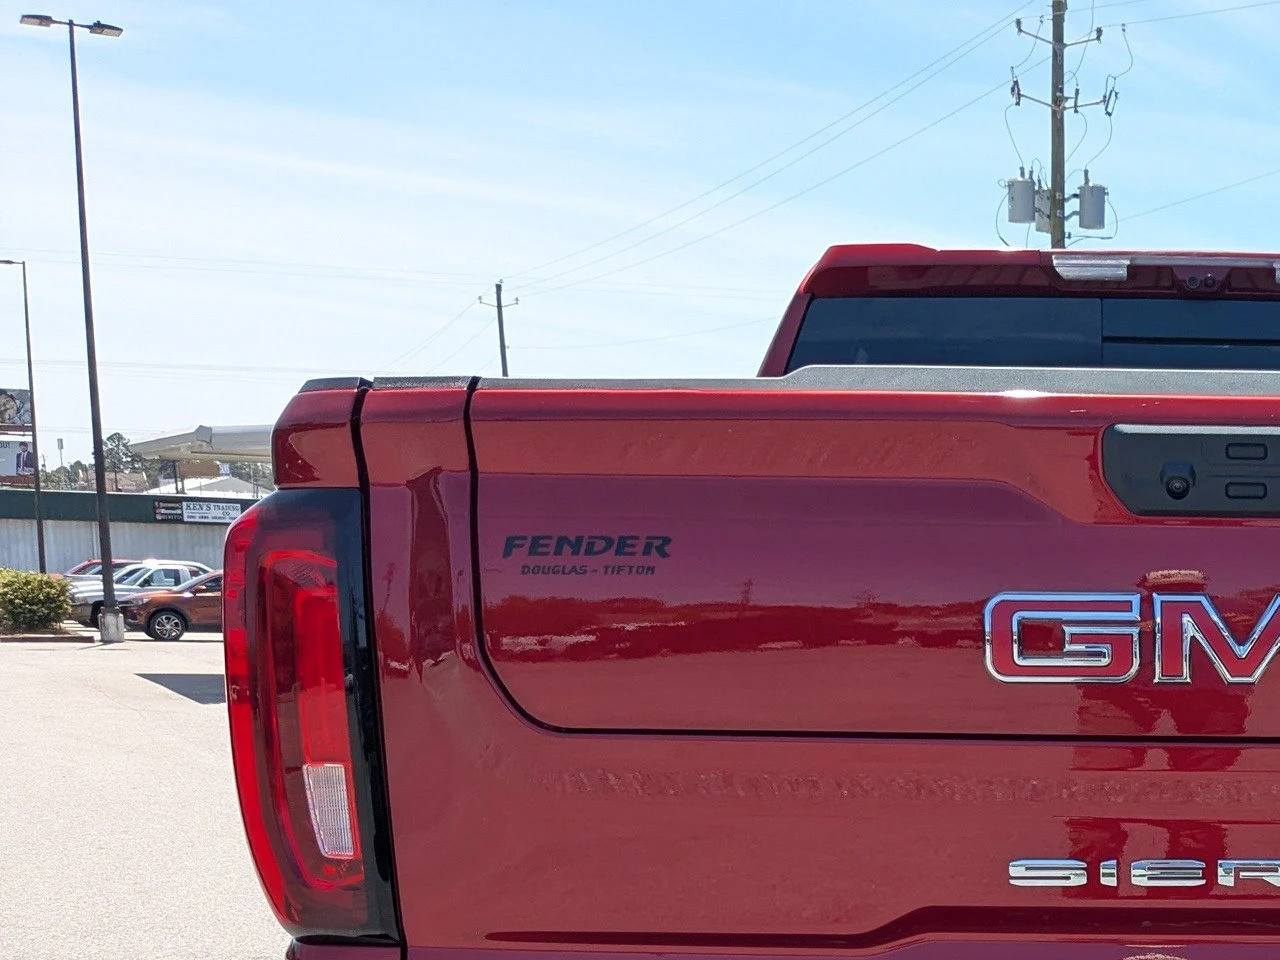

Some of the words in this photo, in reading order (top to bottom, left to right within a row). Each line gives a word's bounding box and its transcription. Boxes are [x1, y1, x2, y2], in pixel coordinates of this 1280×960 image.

[185, 503, 211, 511] KEN'S
[502, 535, 672, 559] FENDER
[521, 565, 588, 575] DOUGLAS
[603, 565, 655, 575] TIFTON
